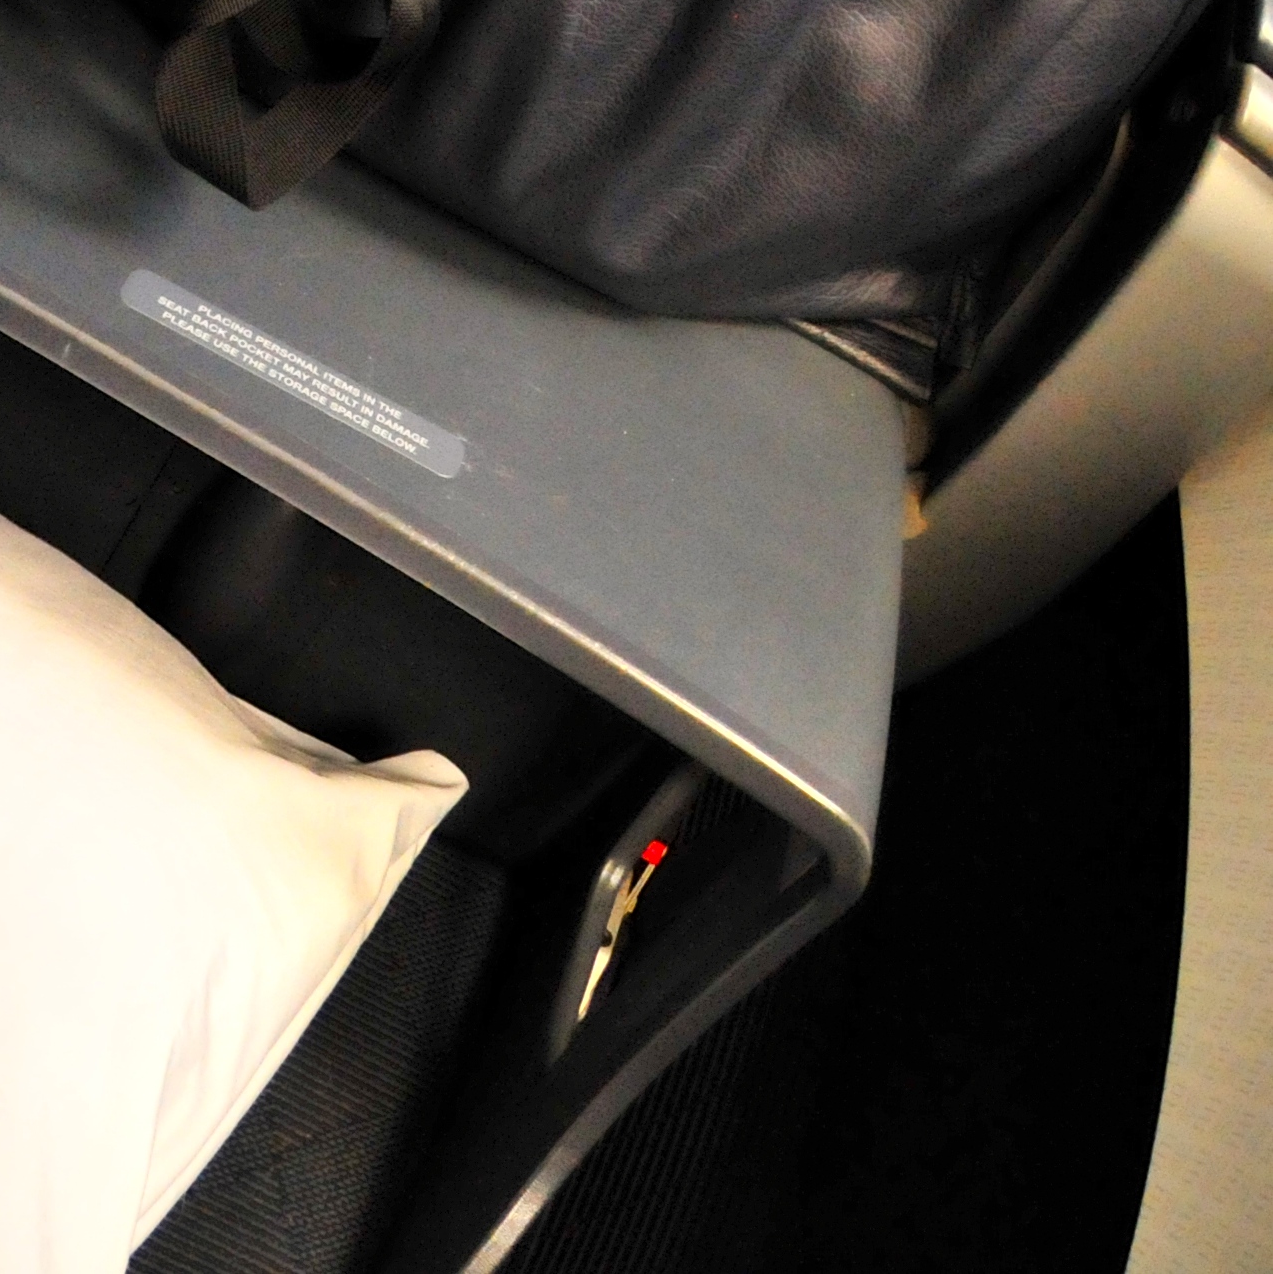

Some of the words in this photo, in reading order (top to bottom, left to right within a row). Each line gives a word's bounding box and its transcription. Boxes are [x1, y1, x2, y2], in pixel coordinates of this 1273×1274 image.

[156, 294, 190, 318] SEAT
[190, 313, 228, 339] BACK
[228, 333, 280, 367] POCKET
[280, 361, 310, 383] MAY
[310, 377, 360, 410] RESULT
[359, 403, 375, 418] IN
[160, 310, 212, 343] PLEASE
[212, 337, 239, 358] USE
[239, 352, 267, 373] THE
[267, 367, 328, 406] STORAGE
[328, 400, 370, 429] SPACE
[196, 303, 254, 340] PLACING
[253, 334, 321, 376] PERSONAL
[321, 370, 362, 398] ITEMS
[361, 392, 378, 406] IN
[375, 399, 403, 420] THE
